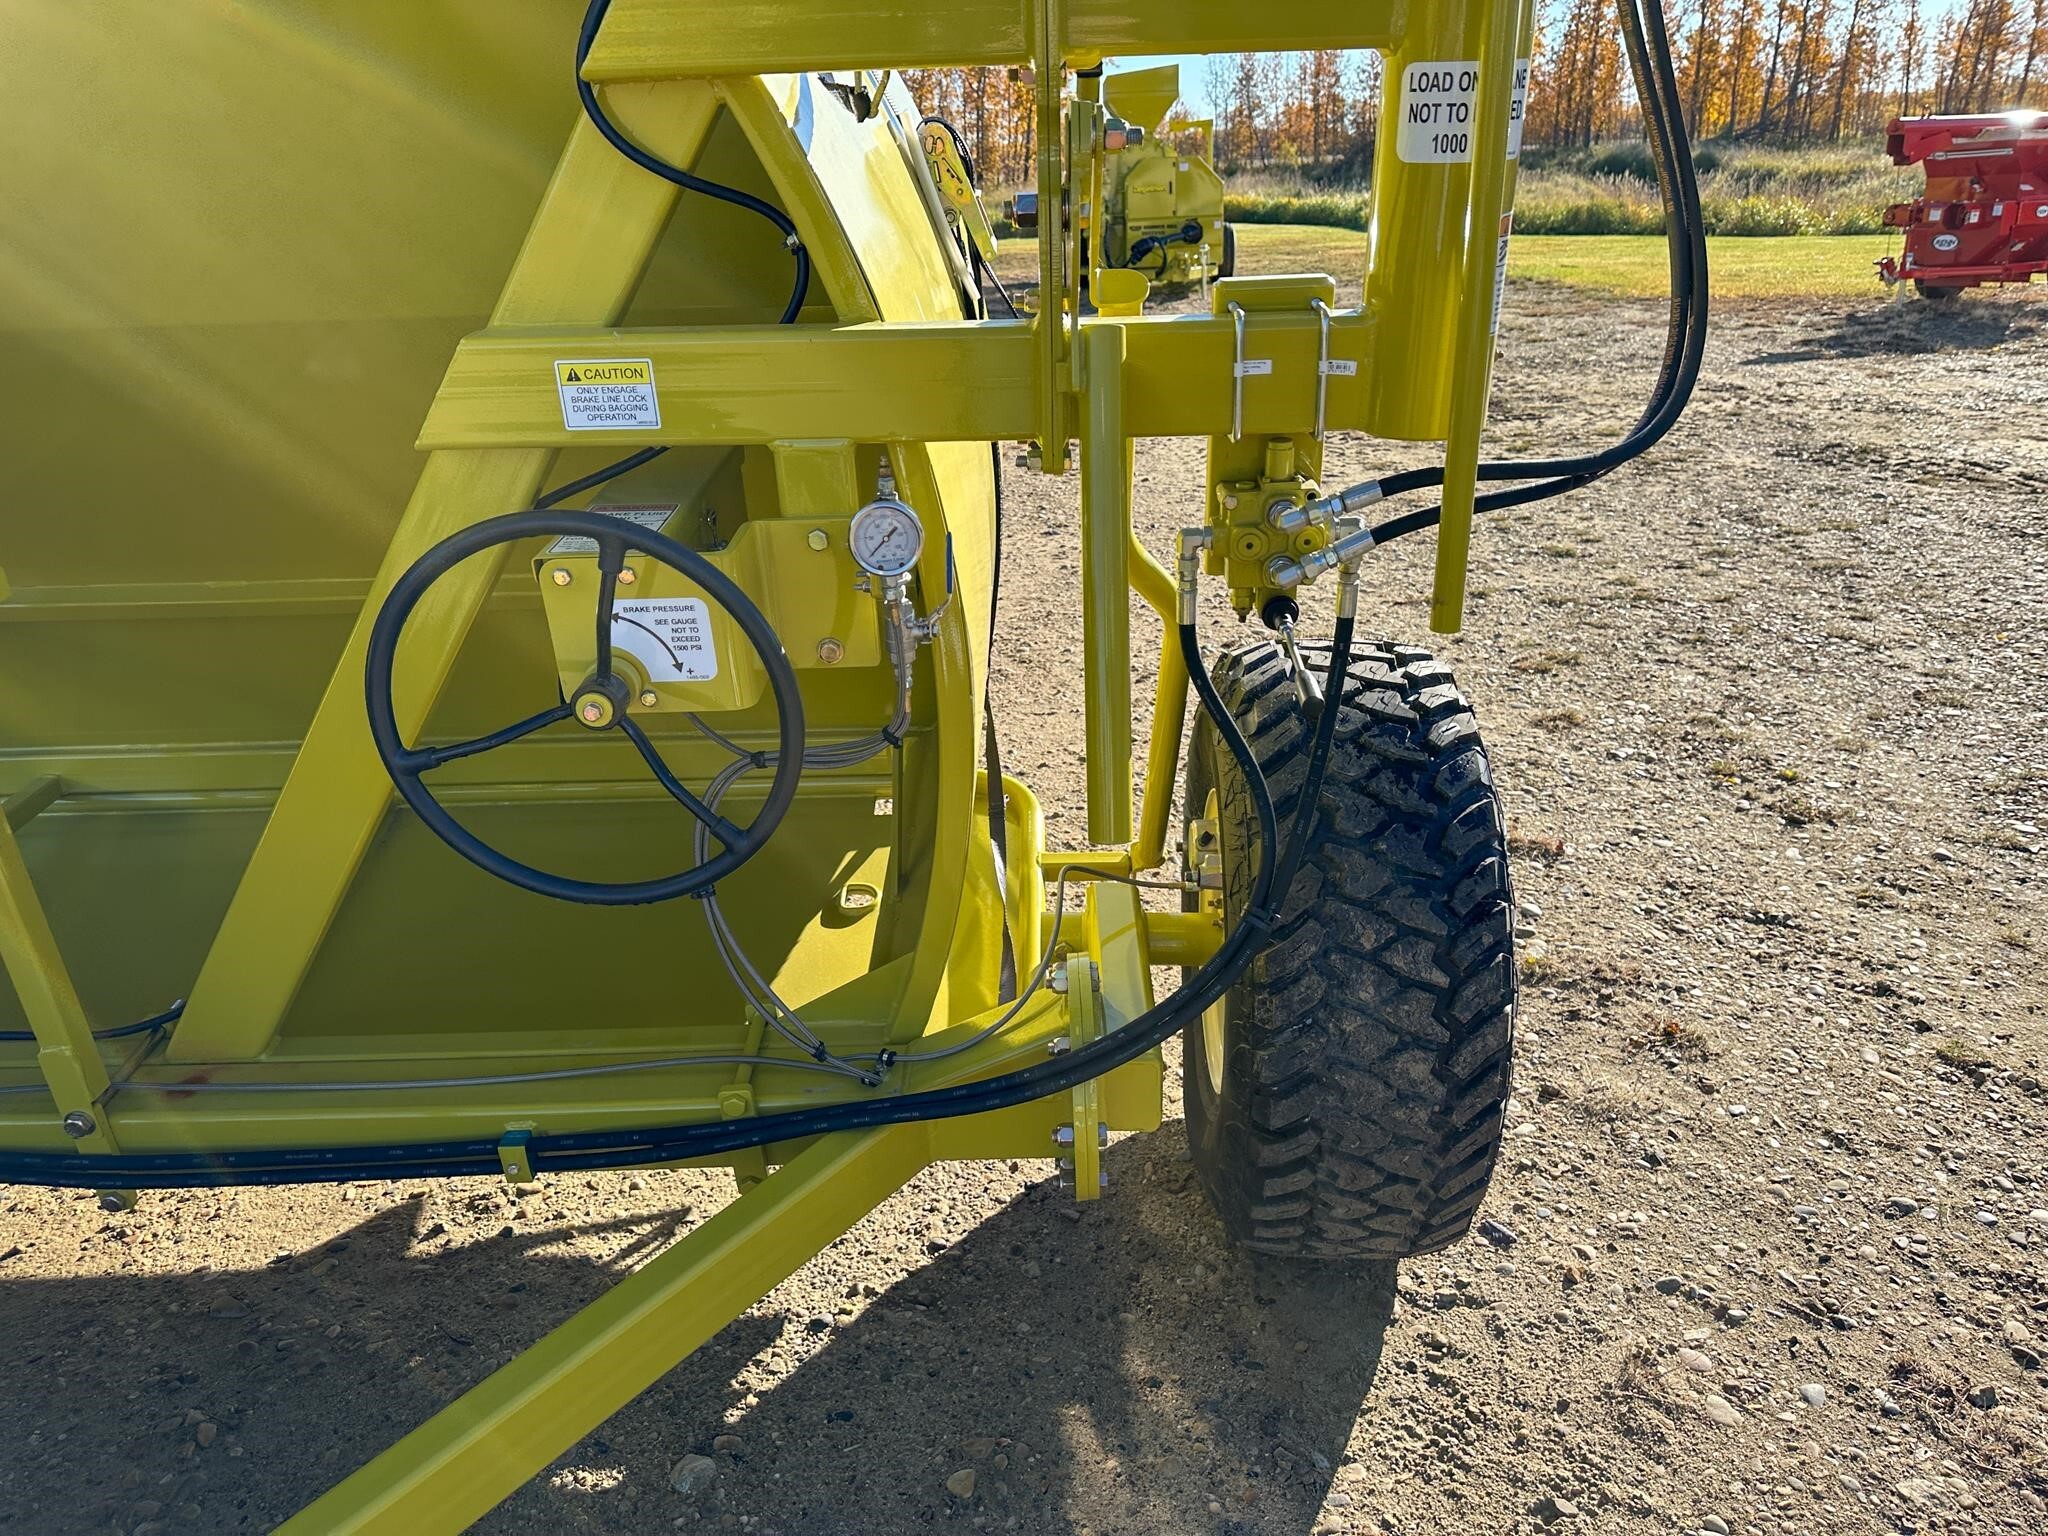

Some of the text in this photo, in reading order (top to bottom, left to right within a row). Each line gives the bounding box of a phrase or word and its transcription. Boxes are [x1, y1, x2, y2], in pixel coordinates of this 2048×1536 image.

[1409, 72, 1454, 93] LOAD
[1408, 103, 1469, 124] NOT TO
[1432, 133, 1468, 154] 1000
[584, 368, 643, 380] CAUTION
[601, 386, 637, 394] ENGAGE
[571, 395, 647, 404] BRAKE LINE LOCK
[609, 404, 649, 412] BAGGING
[587, 413, 637, 421] OPERATION
